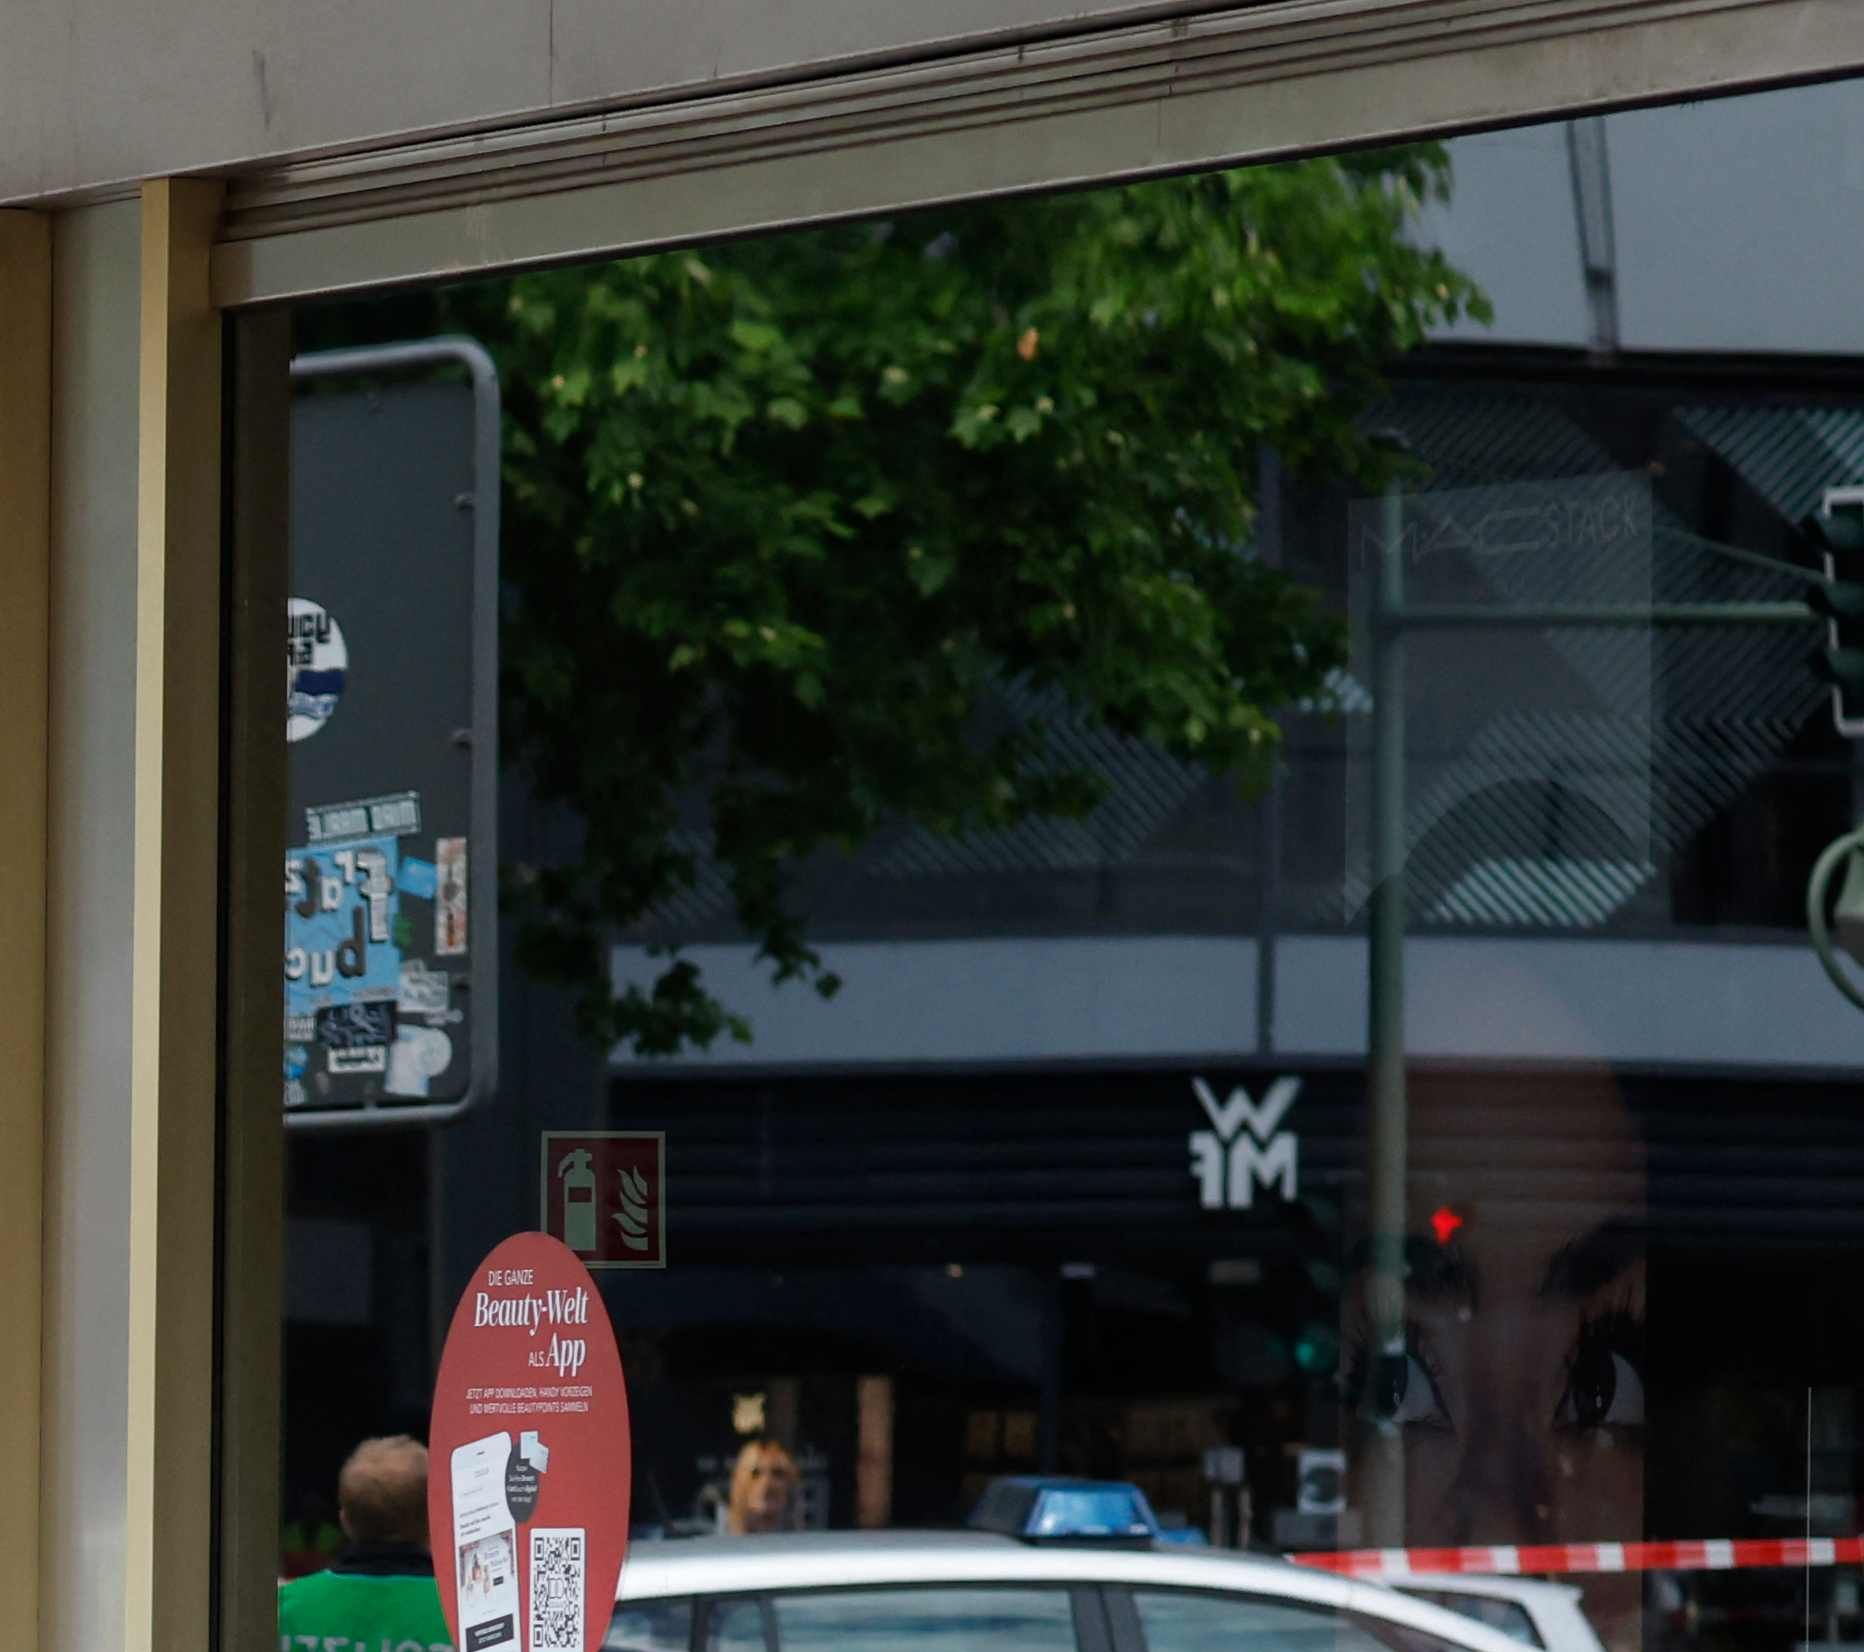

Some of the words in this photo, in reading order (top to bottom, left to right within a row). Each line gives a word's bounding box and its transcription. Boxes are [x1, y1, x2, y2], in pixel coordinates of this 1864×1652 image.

[488, 1270, 503, 1286] DIE
[504, 1269, 534, 1286] GANZE
[474, 1286, 589, 1336] Beauty-Welt
[528, 1351, 545, 1367] ALS
[545, 1332, 586, 1377] App
